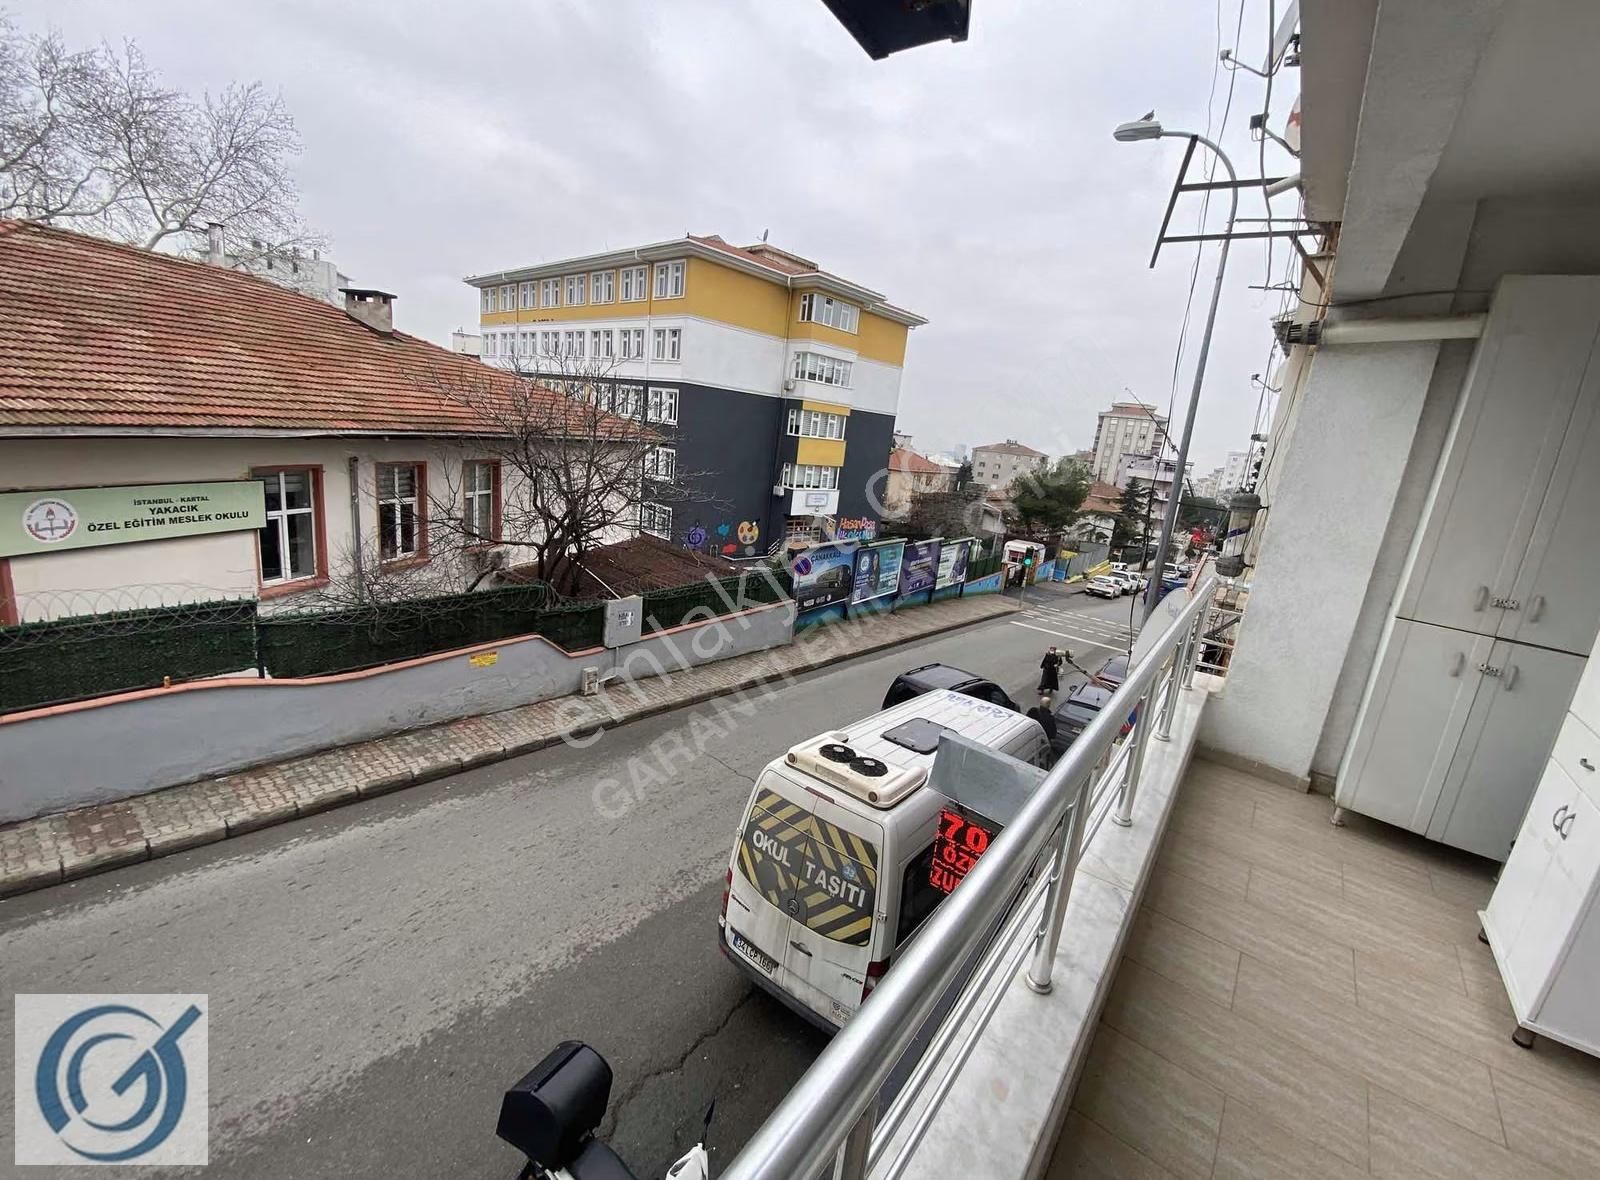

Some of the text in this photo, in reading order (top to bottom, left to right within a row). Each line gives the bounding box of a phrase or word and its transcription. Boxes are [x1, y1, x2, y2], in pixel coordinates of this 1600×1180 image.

[134, 498, 174, 506] İSTANBUL
[149, 504, 199, 515] YAKACIK
[87, 511, 249, 532] ÖZEL EĞİTİM MESLEK OKULU
[943, 812, 988, 853] 70
[752, 829, 866, 908] OKUL TAŞITI
